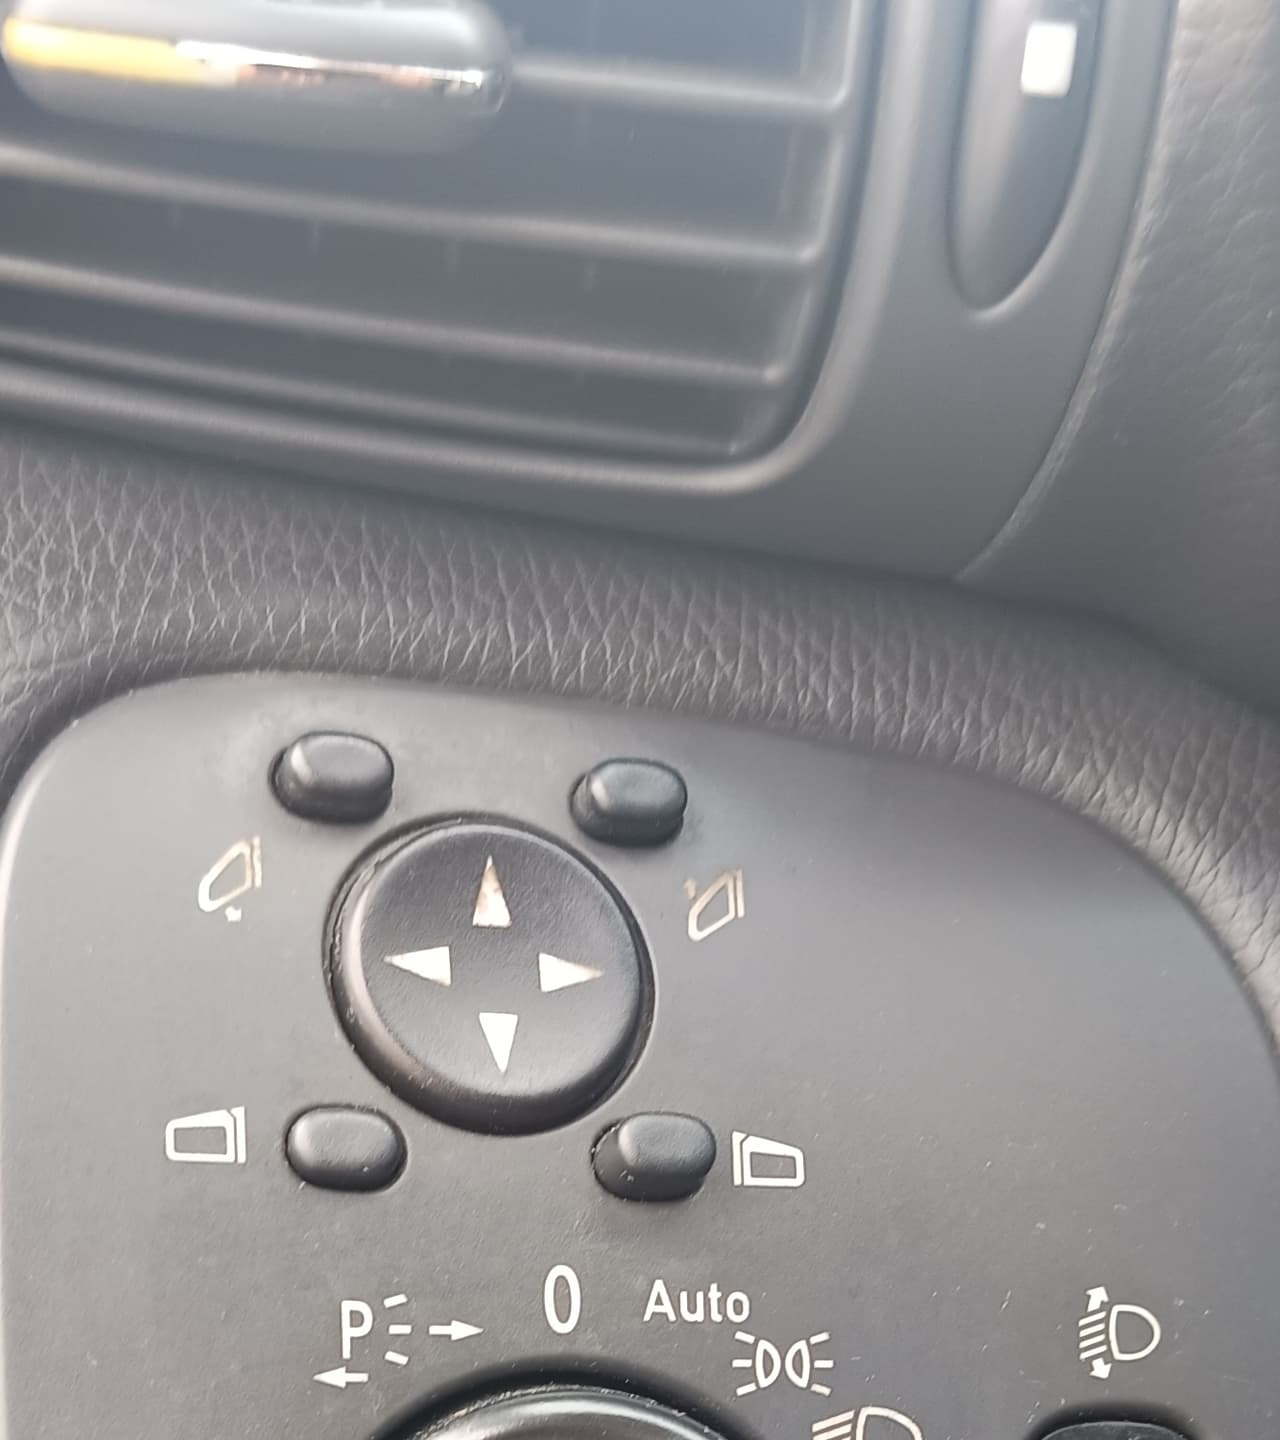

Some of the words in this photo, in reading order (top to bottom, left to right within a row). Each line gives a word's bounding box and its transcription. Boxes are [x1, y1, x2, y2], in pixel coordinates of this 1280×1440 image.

[543, 1263, 582, 1334] 0
[643, 1279, 751, 1324] Auto
[340, 1299, 374, 1360] P
